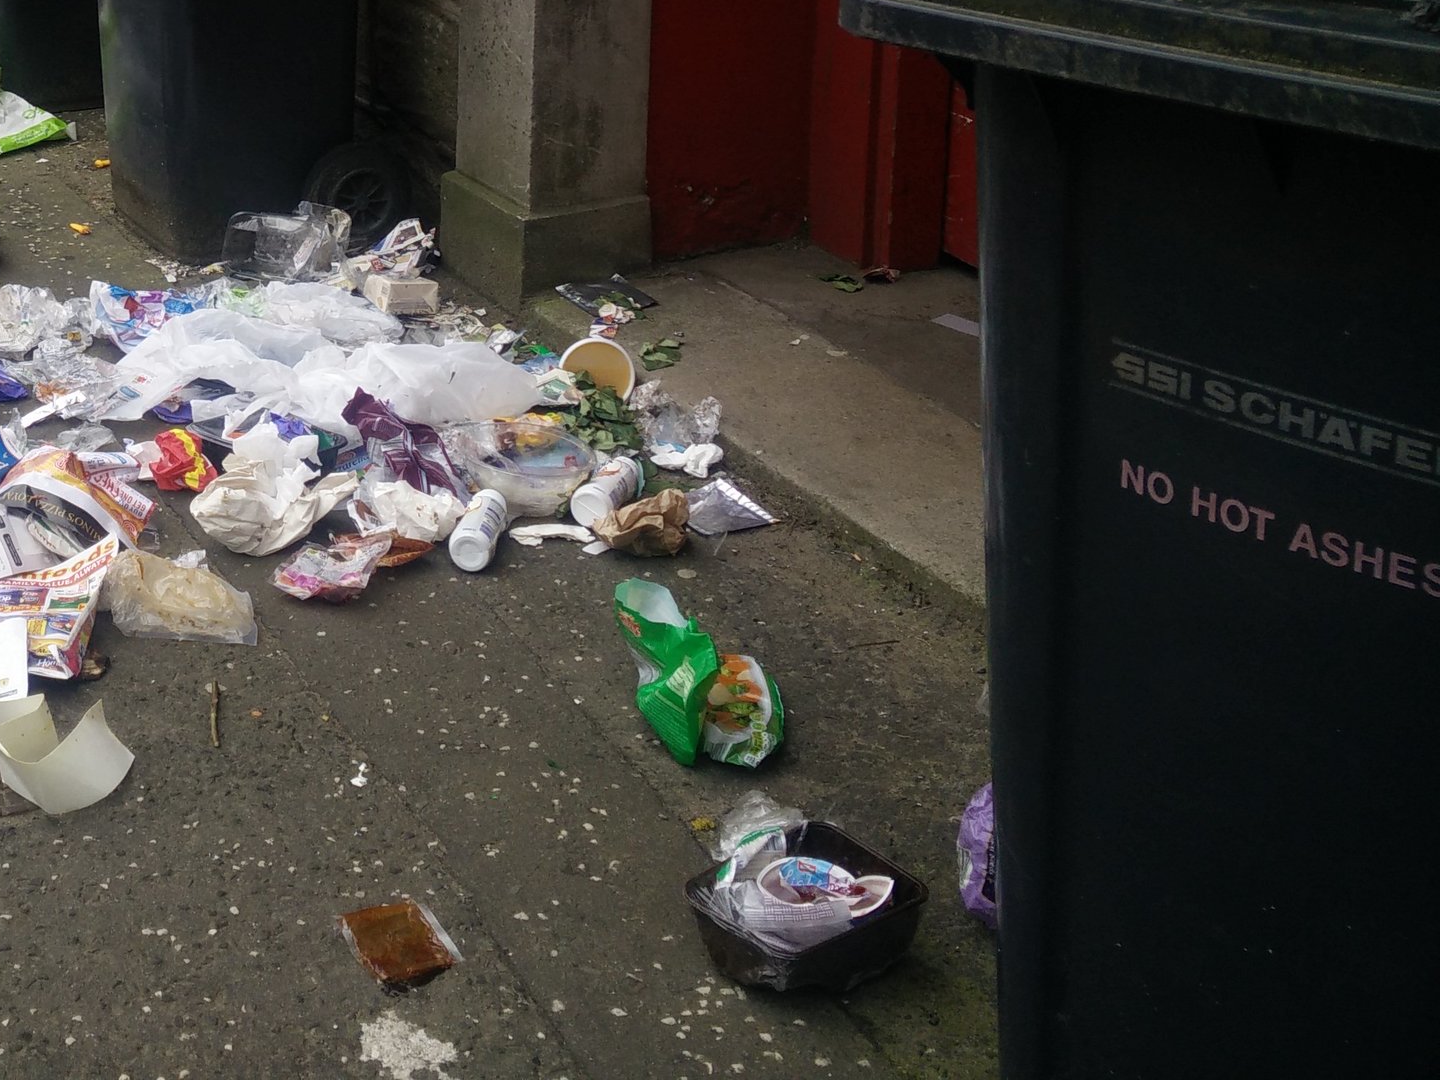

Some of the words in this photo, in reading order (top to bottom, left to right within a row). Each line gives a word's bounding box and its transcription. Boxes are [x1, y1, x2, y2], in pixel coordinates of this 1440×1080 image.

[1112, 351, 1191, 401] SSI
[34, 496, 66, 518] PIZZA
[118, 490, 132, 504] ONE
[130, 498, 147, 512] GET
[1120, 458, 1175, 506] NO
[1191, 486, 1275, 541] HOT
[1288, 523, 1440, 599] ASHES
